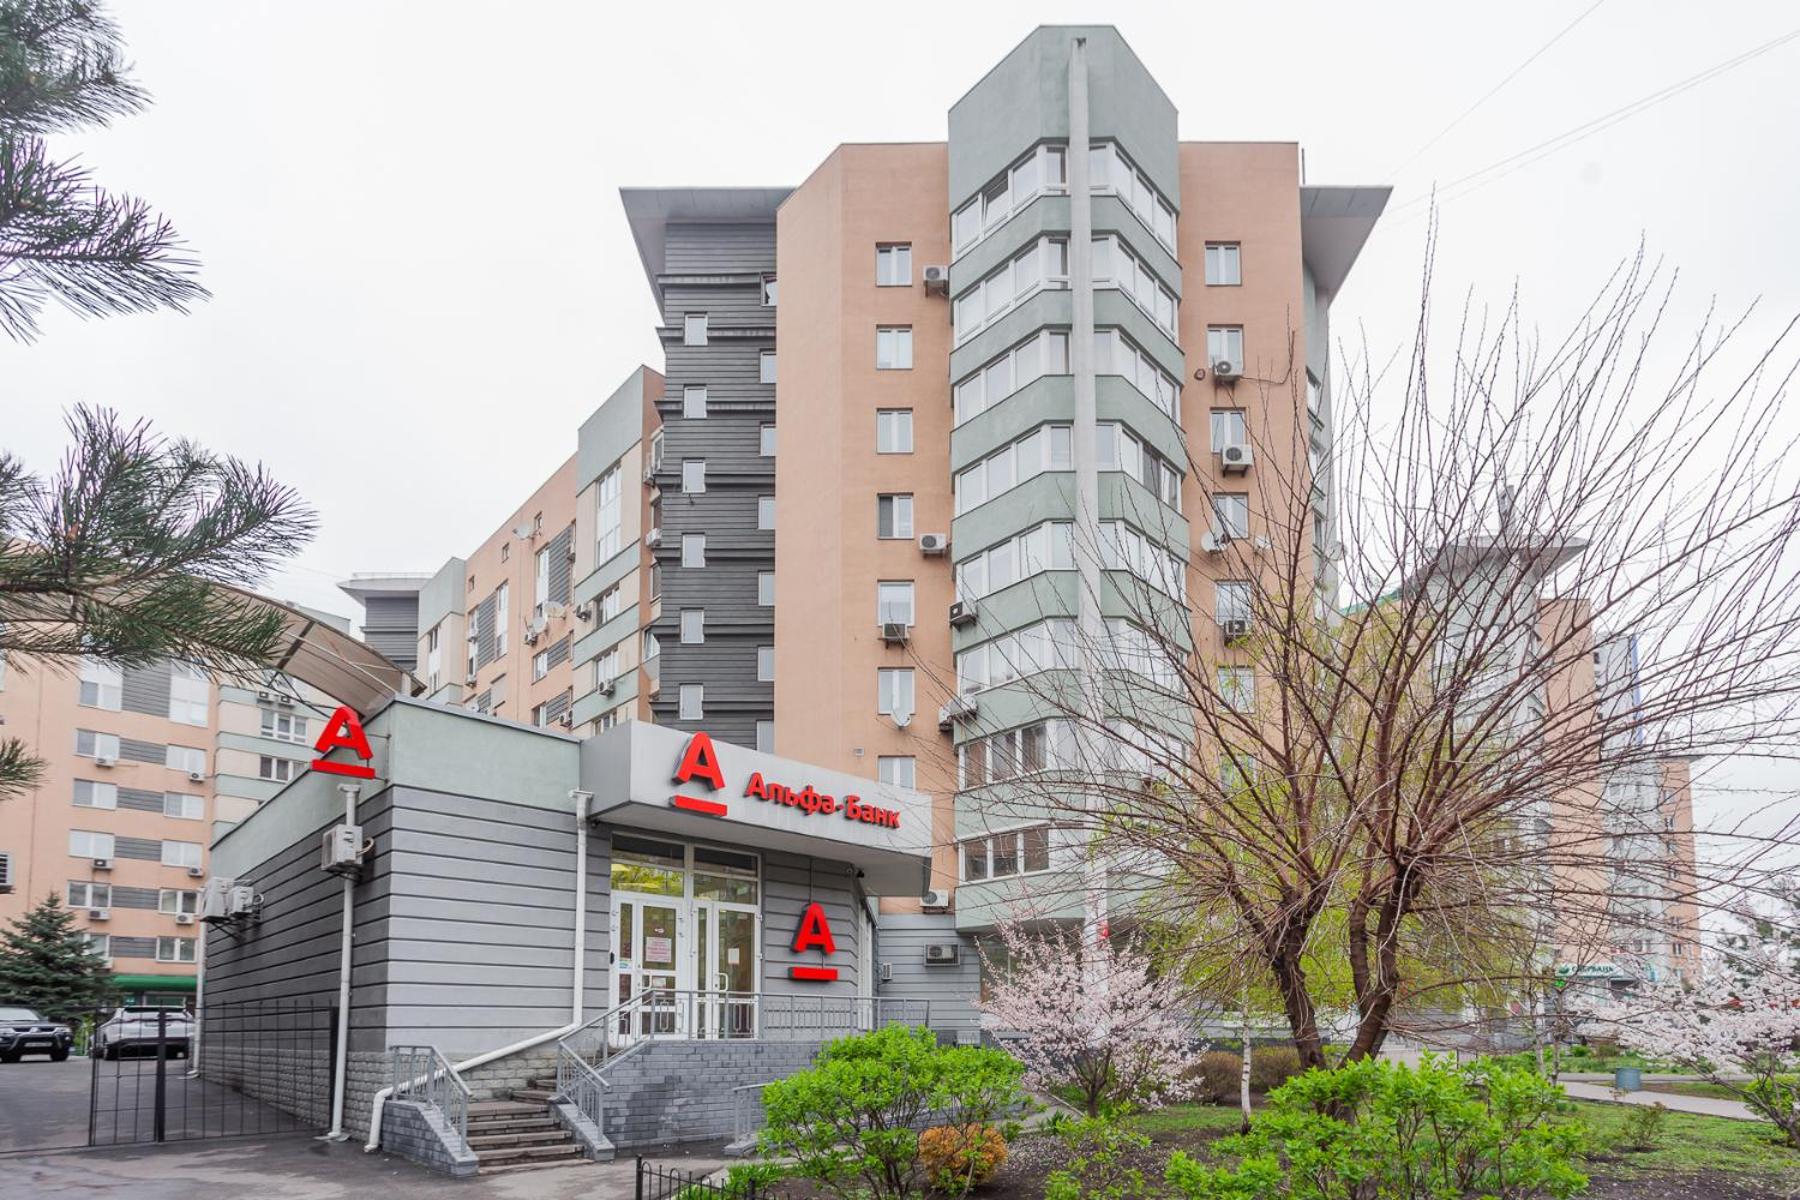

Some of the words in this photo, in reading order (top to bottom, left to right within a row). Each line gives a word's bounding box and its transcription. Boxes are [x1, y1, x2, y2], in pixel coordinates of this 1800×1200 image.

[315, 706, 373, 759] А
[675, 731, 726, 791] А
[793, 902, 836, 955] А
